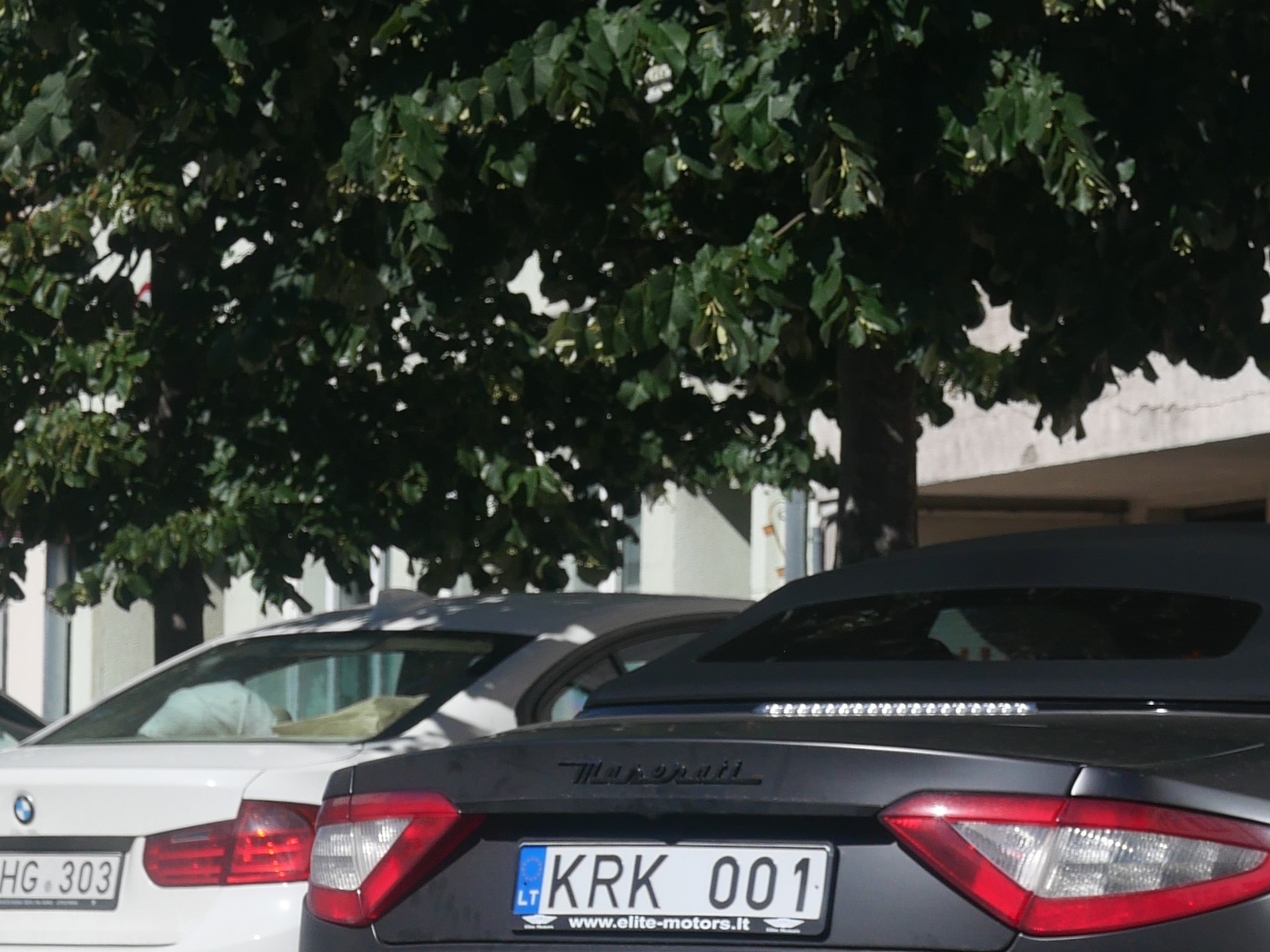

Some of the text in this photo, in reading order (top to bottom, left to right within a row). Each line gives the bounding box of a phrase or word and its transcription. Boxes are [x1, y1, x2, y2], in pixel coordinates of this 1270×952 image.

[557, 759, 763, 786] Maserati
[548, 854, 811, 912] KRK 001
[517, 889, 540, 908] LT
[568, 914, 751, 932] www.elite-motors.lt
